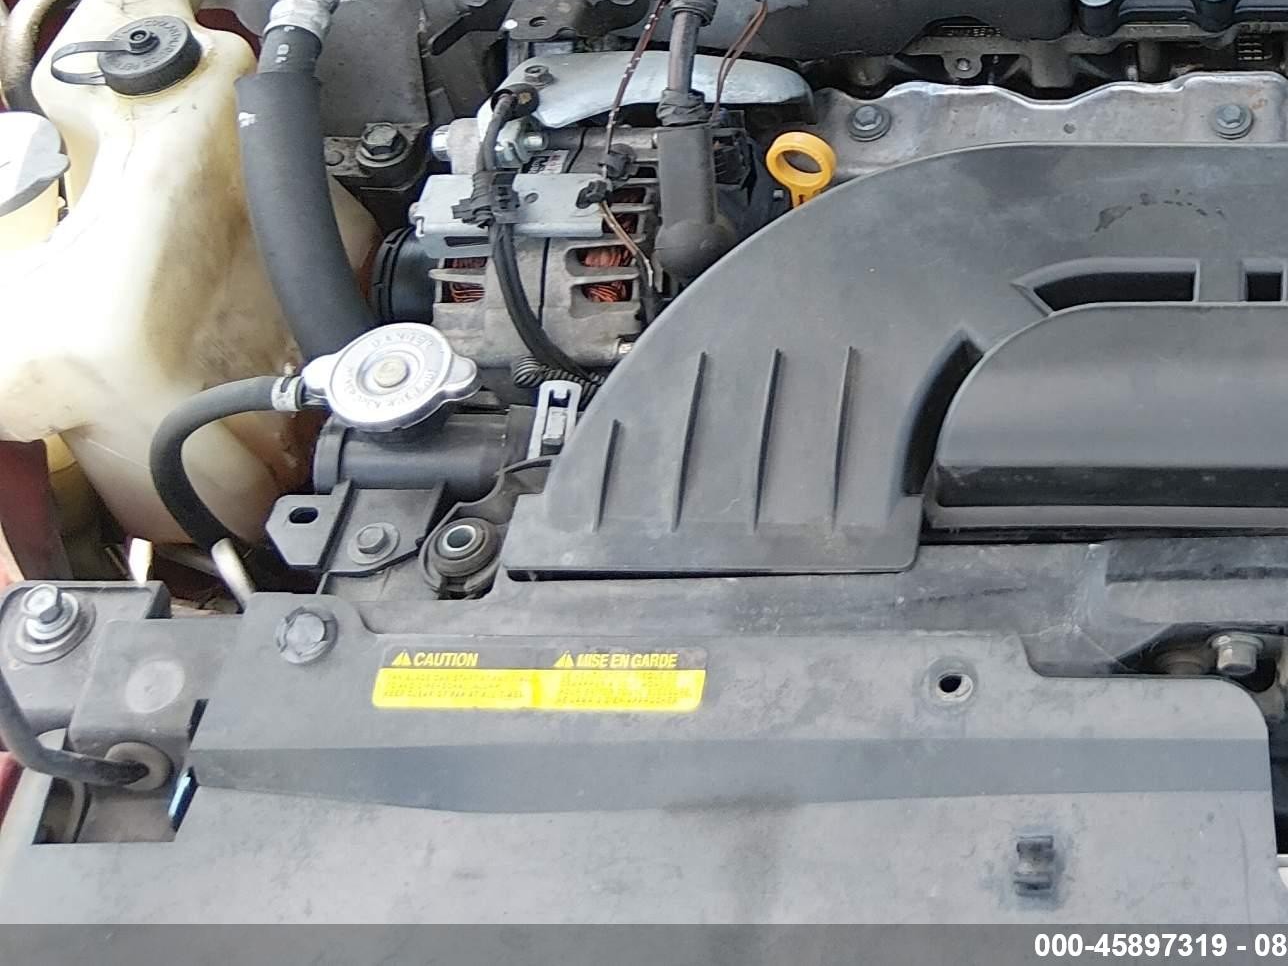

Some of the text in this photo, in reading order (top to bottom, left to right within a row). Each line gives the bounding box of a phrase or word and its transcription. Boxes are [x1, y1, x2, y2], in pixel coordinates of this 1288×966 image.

[413, 651, 479, 667] CAUTION
[576, 653, 679, 668] MISE EN GARDE
